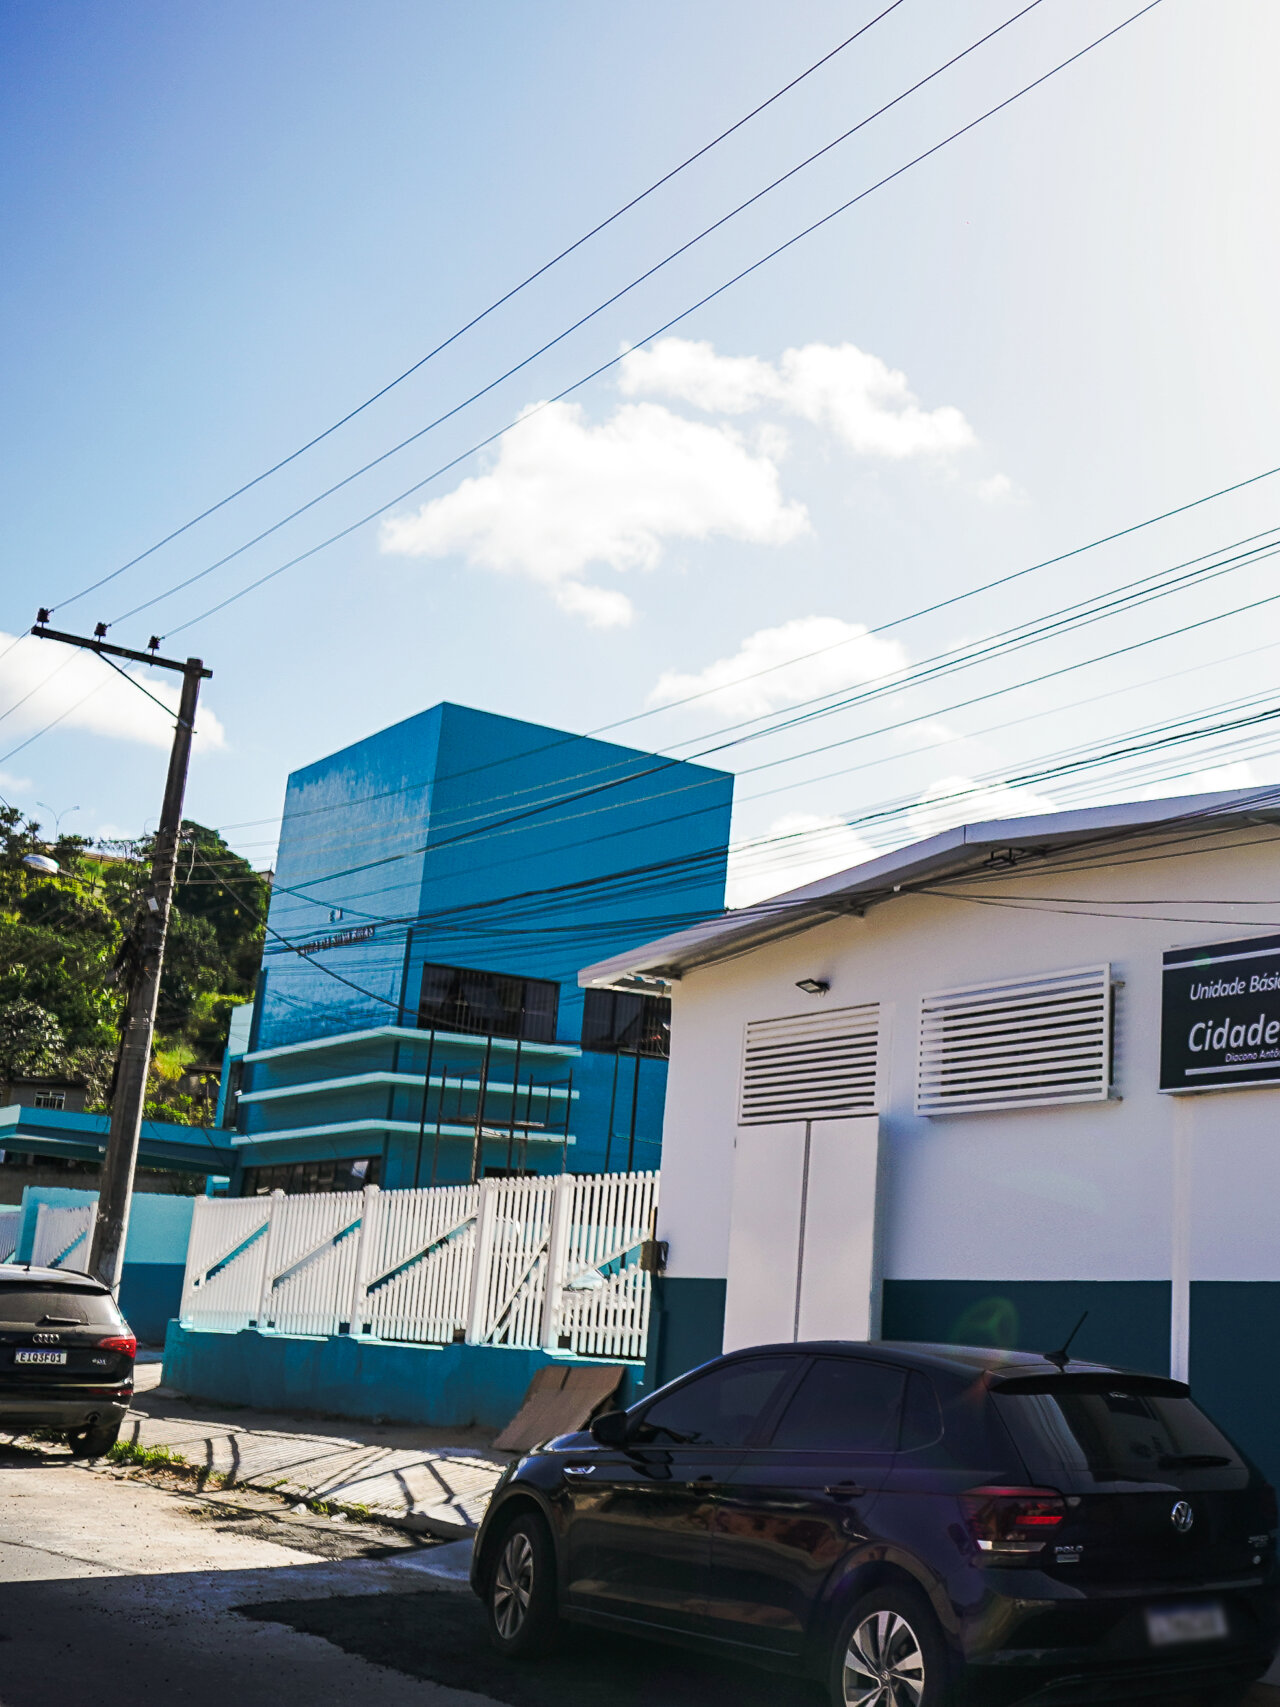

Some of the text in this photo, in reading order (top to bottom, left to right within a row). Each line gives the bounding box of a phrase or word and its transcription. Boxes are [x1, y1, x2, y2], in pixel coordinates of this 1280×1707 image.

[1190, 977, 1245, 1000] Unidade
[1188, 1013, 1280, 1052] Cidade
[1054, 1545, 1084, 1554] POLO
